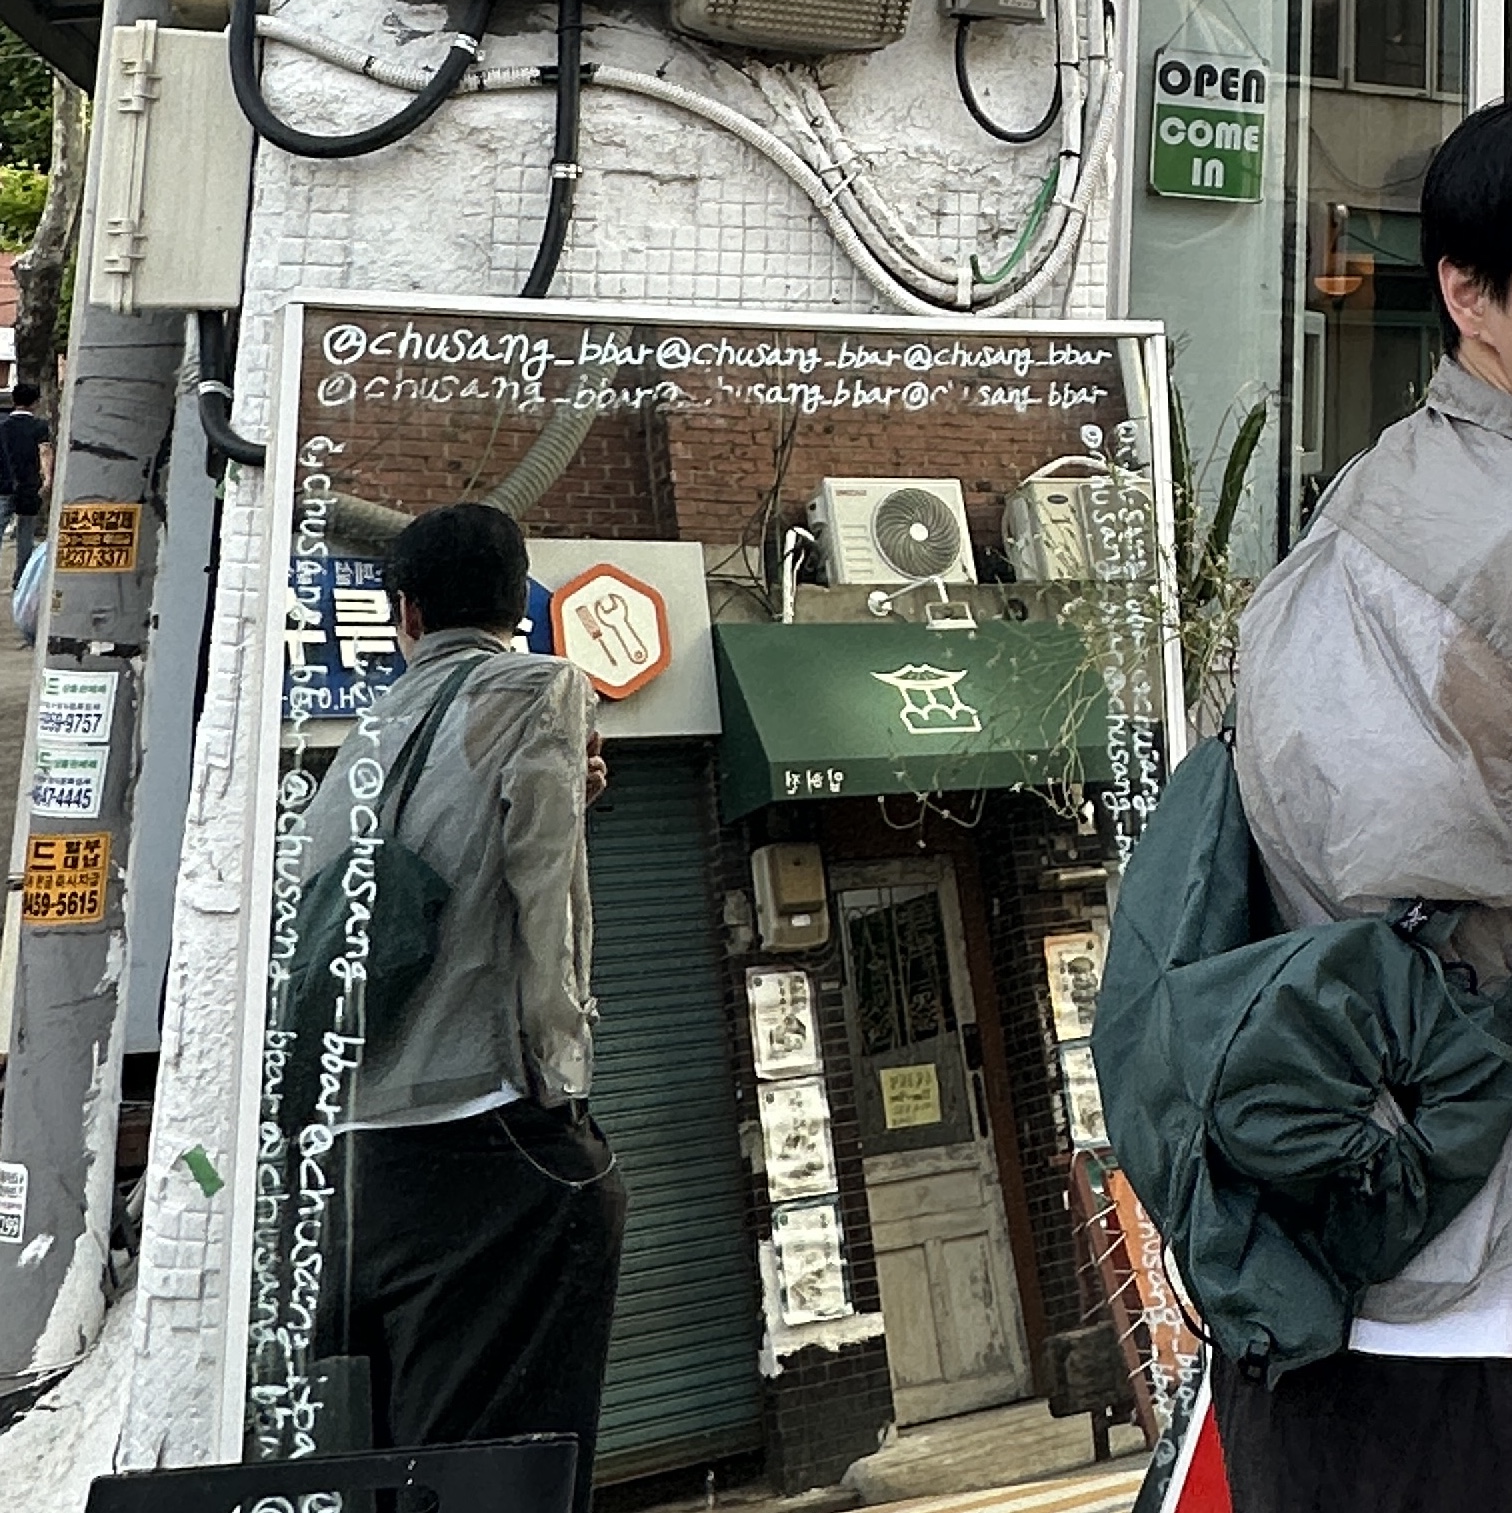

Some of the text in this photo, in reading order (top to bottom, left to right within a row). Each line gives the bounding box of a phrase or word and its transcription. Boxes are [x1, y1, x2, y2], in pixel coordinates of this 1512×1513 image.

[1159, 60, 1266, 104] OPEN
[1159, 116, 1260, 154] COME
[1191, 157, 1225, 188] IN
